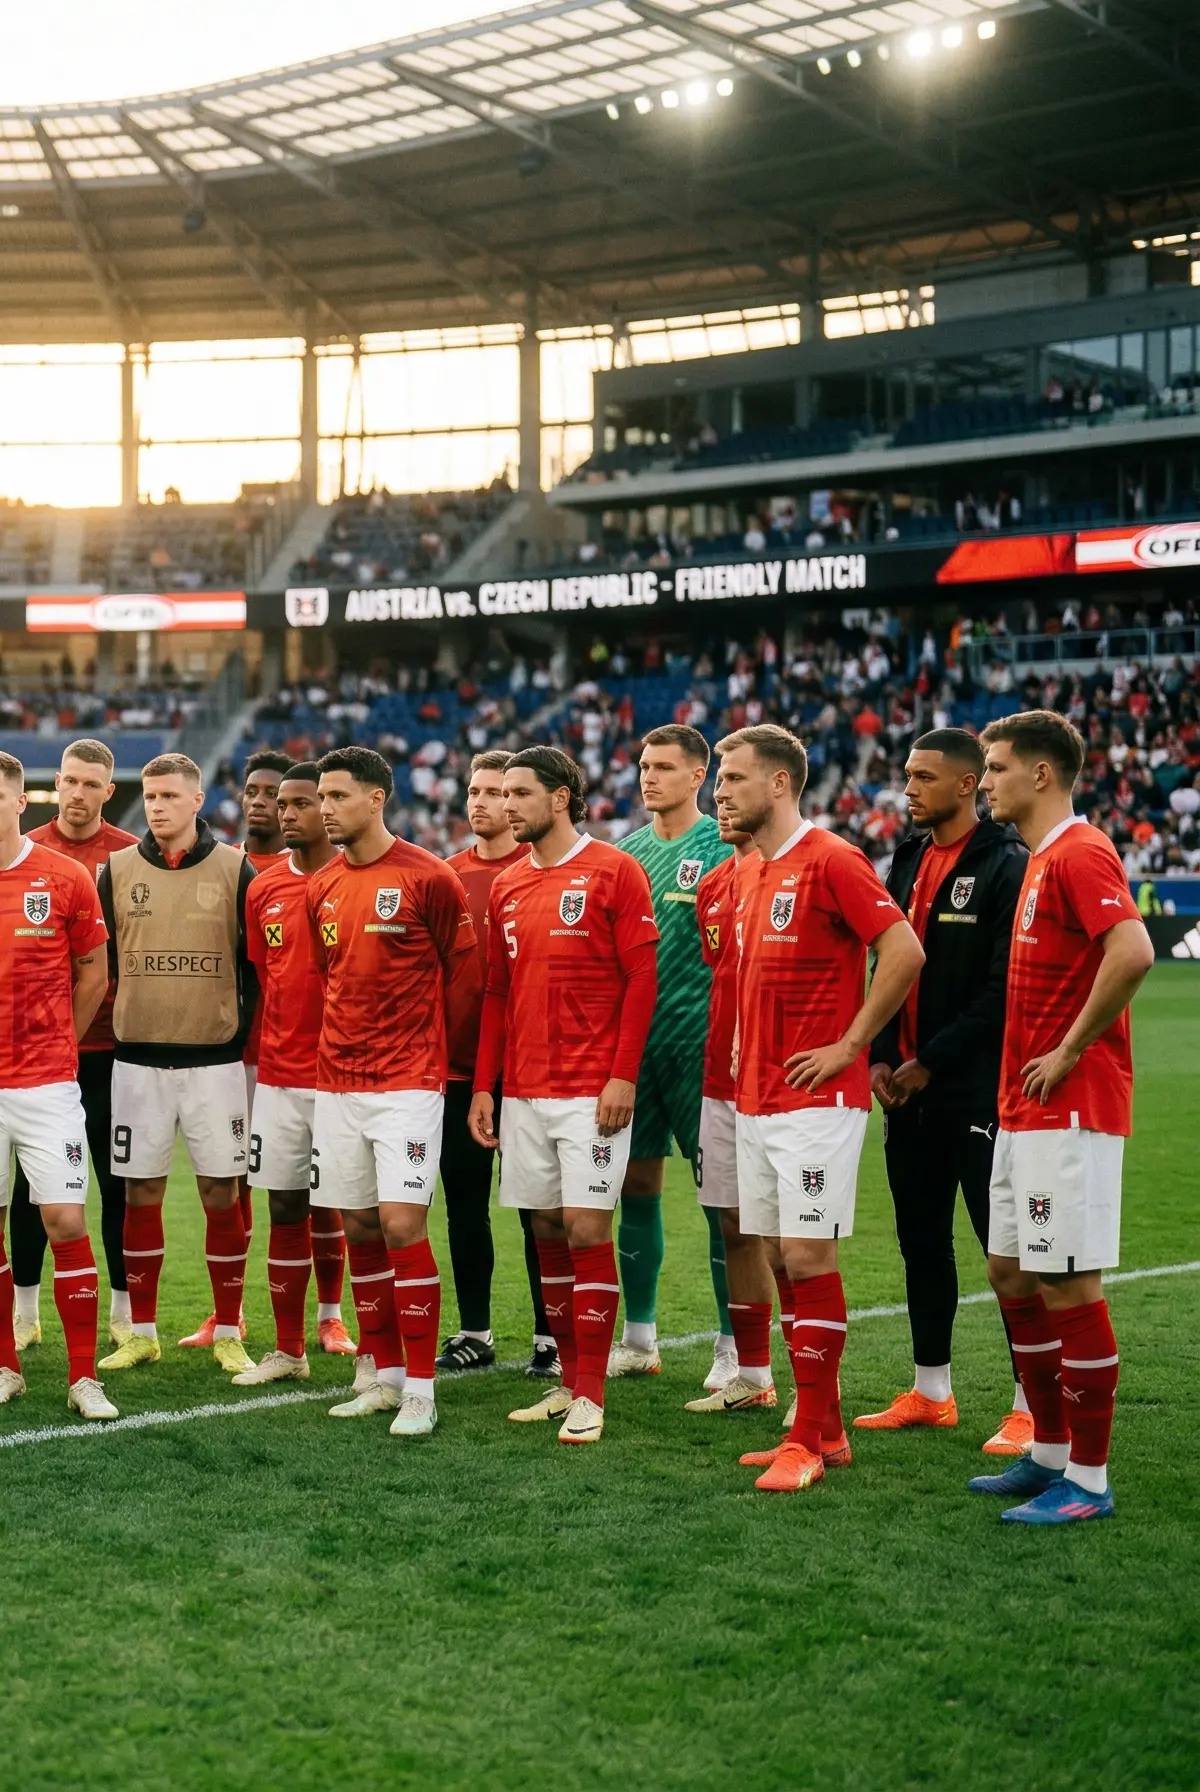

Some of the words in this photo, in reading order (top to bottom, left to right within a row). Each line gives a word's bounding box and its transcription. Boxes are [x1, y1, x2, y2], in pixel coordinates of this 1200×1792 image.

[1149, 538, 1200, 555] OF
[345, 586, 443, 622] AUSTRIA
[445, 591, 476, 617] vs.
[479, 580, 548, 615] CZECH
[552, 571, 658, 611] REPUBLIC
[675, 561, 782, 601] FRIENDLY
[786, 555, 865, 593] MATCH
[503, 920, 518, 959] 5
[144, 955, 223, 974] RESPECT
[113, 1125, 132, 1164] 9
